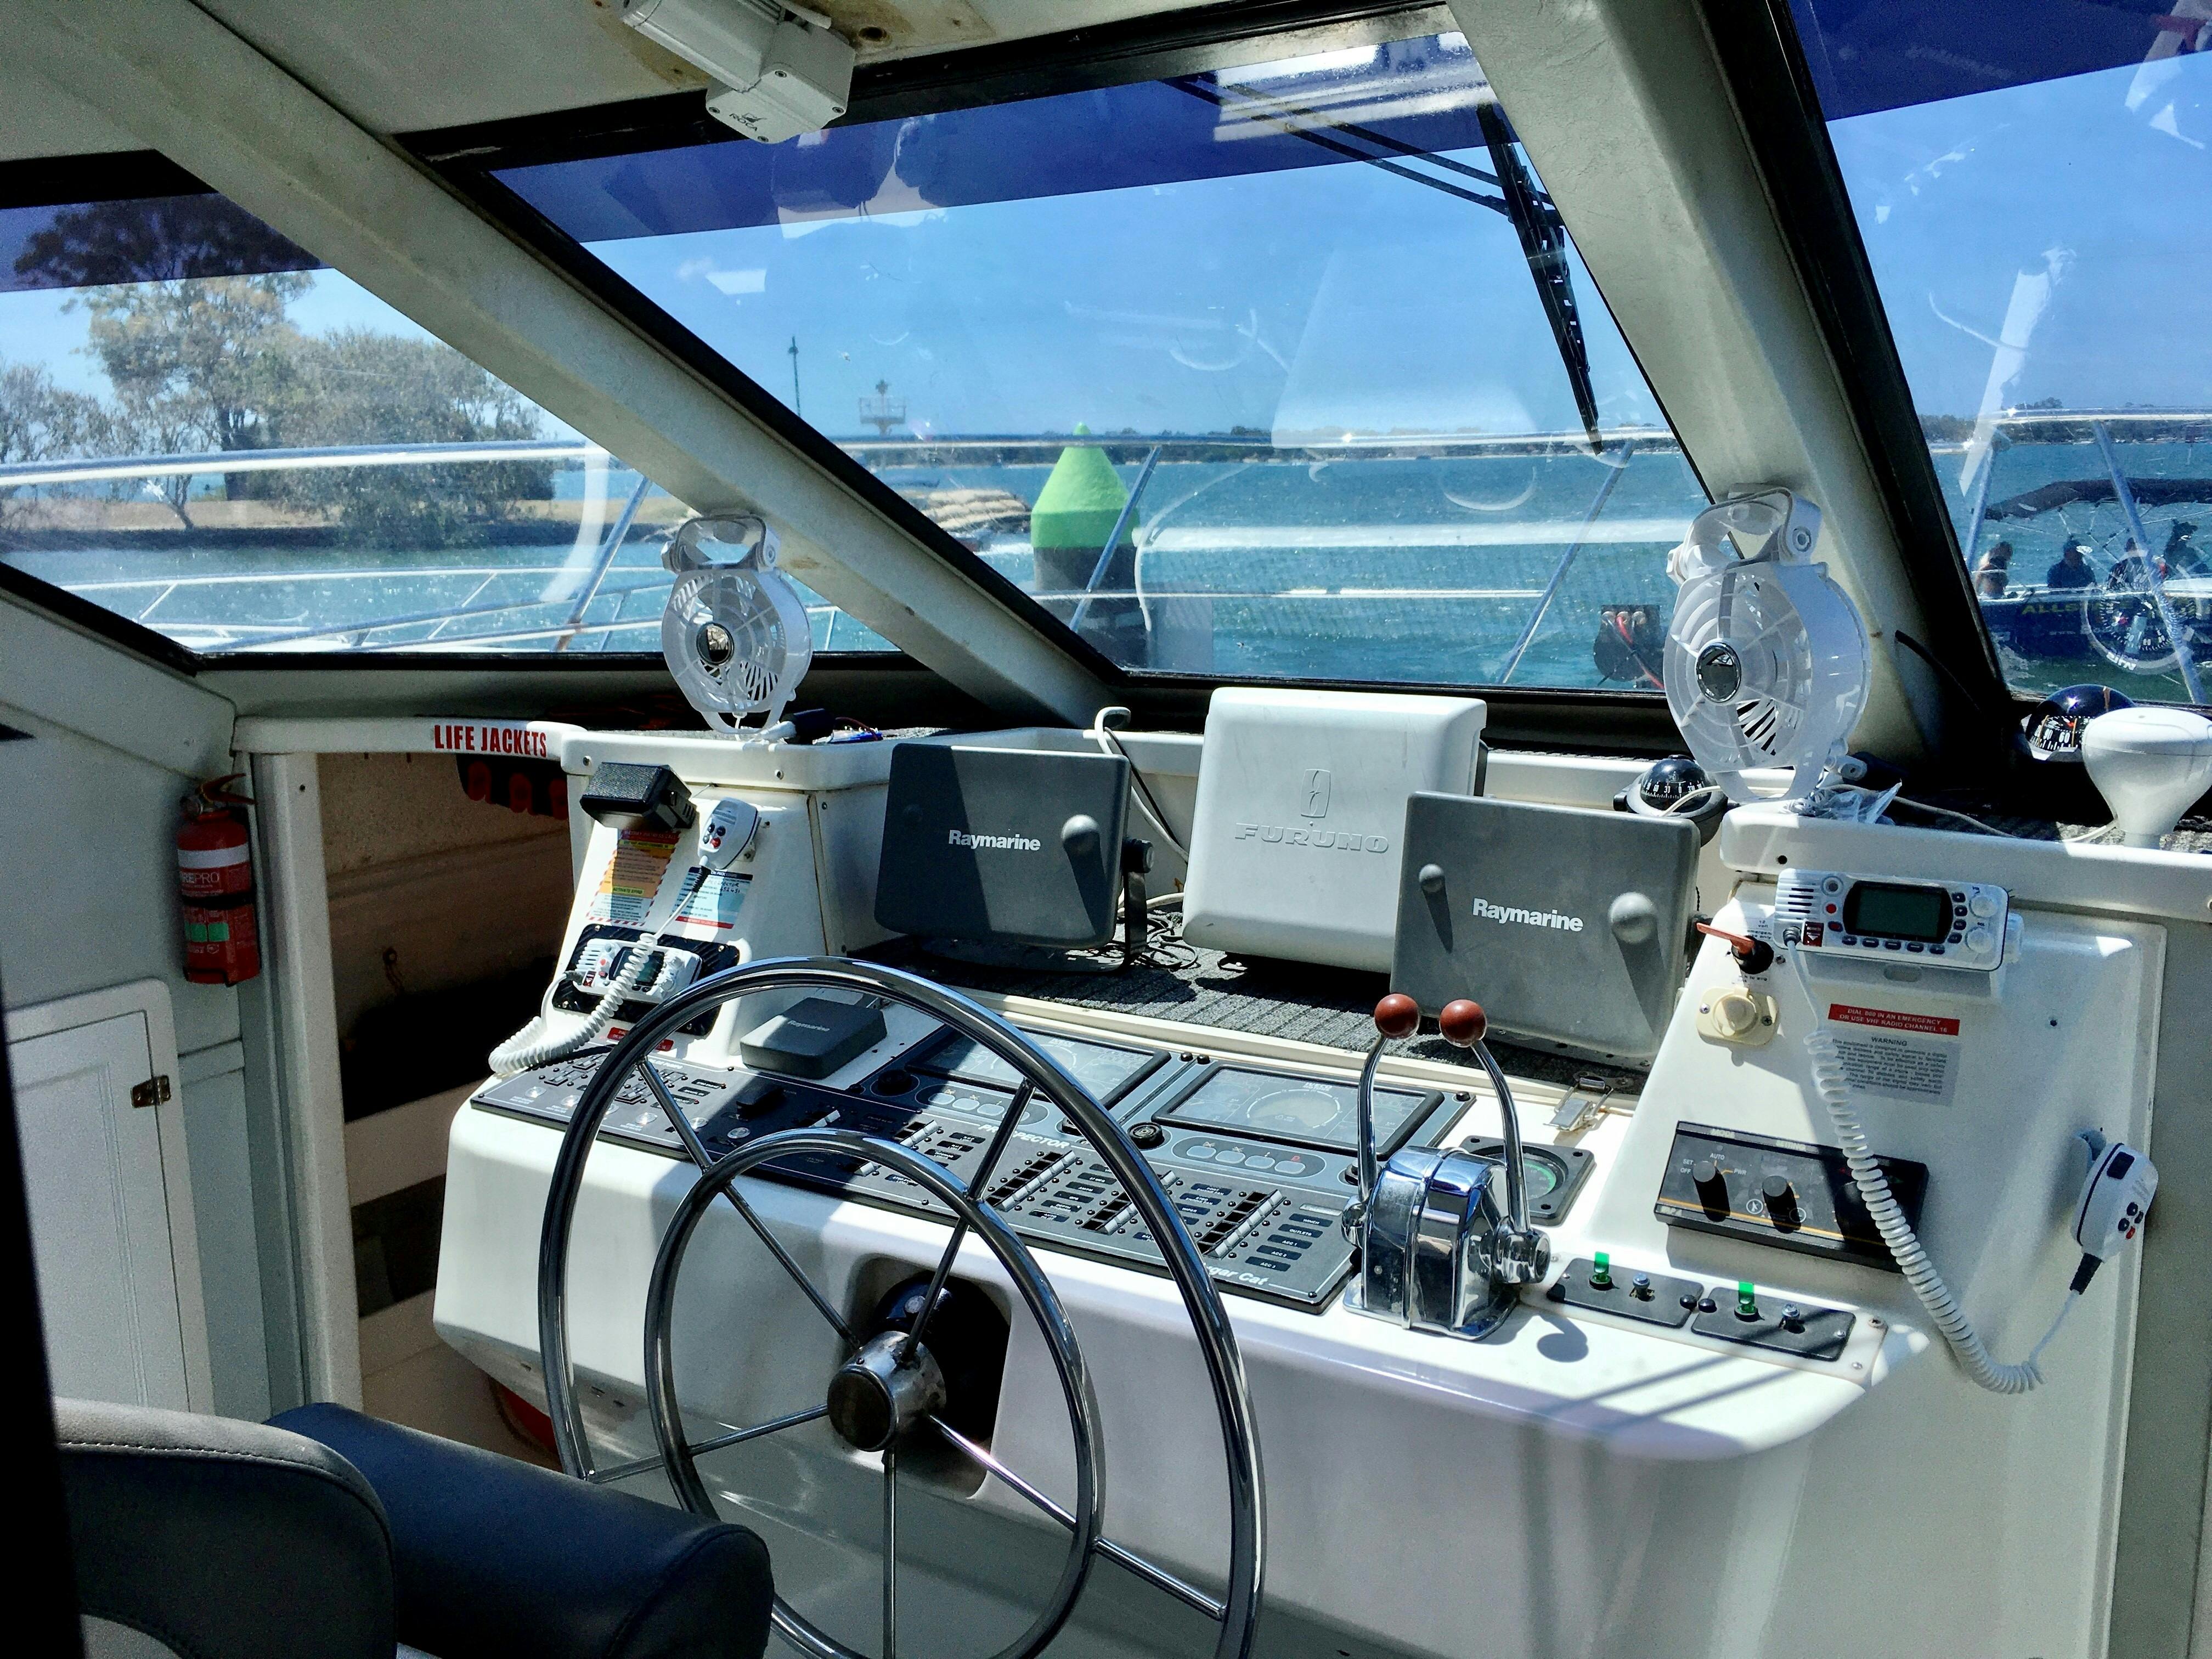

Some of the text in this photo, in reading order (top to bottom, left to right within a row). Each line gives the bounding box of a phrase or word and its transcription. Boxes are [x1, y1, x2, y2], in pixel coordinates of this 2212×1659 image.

[729, 113, 757, 131] ROCA
[434, 725, 547, 758] LIFE JACKETS
[948, 829, 1041, 852] Raymarine
[1234, 822, 1389, 854] FURUNO
[1473, 898, 1583, 933] Raymarine
[787, 1020, 830, 1032] Raymarine
[1881, 1019, 1903, 1028] RADIO
[1905, 1022, 1938, 1032] CHANNEL
[1898, 1014, 1941, 1025] EMERGENCY
[1871, 1036, 1908, 1046] WARNING
[978, 1124, 1070, 1149] PRPECTOR
[1203, 1262, 1269, 1285] gar Cat
